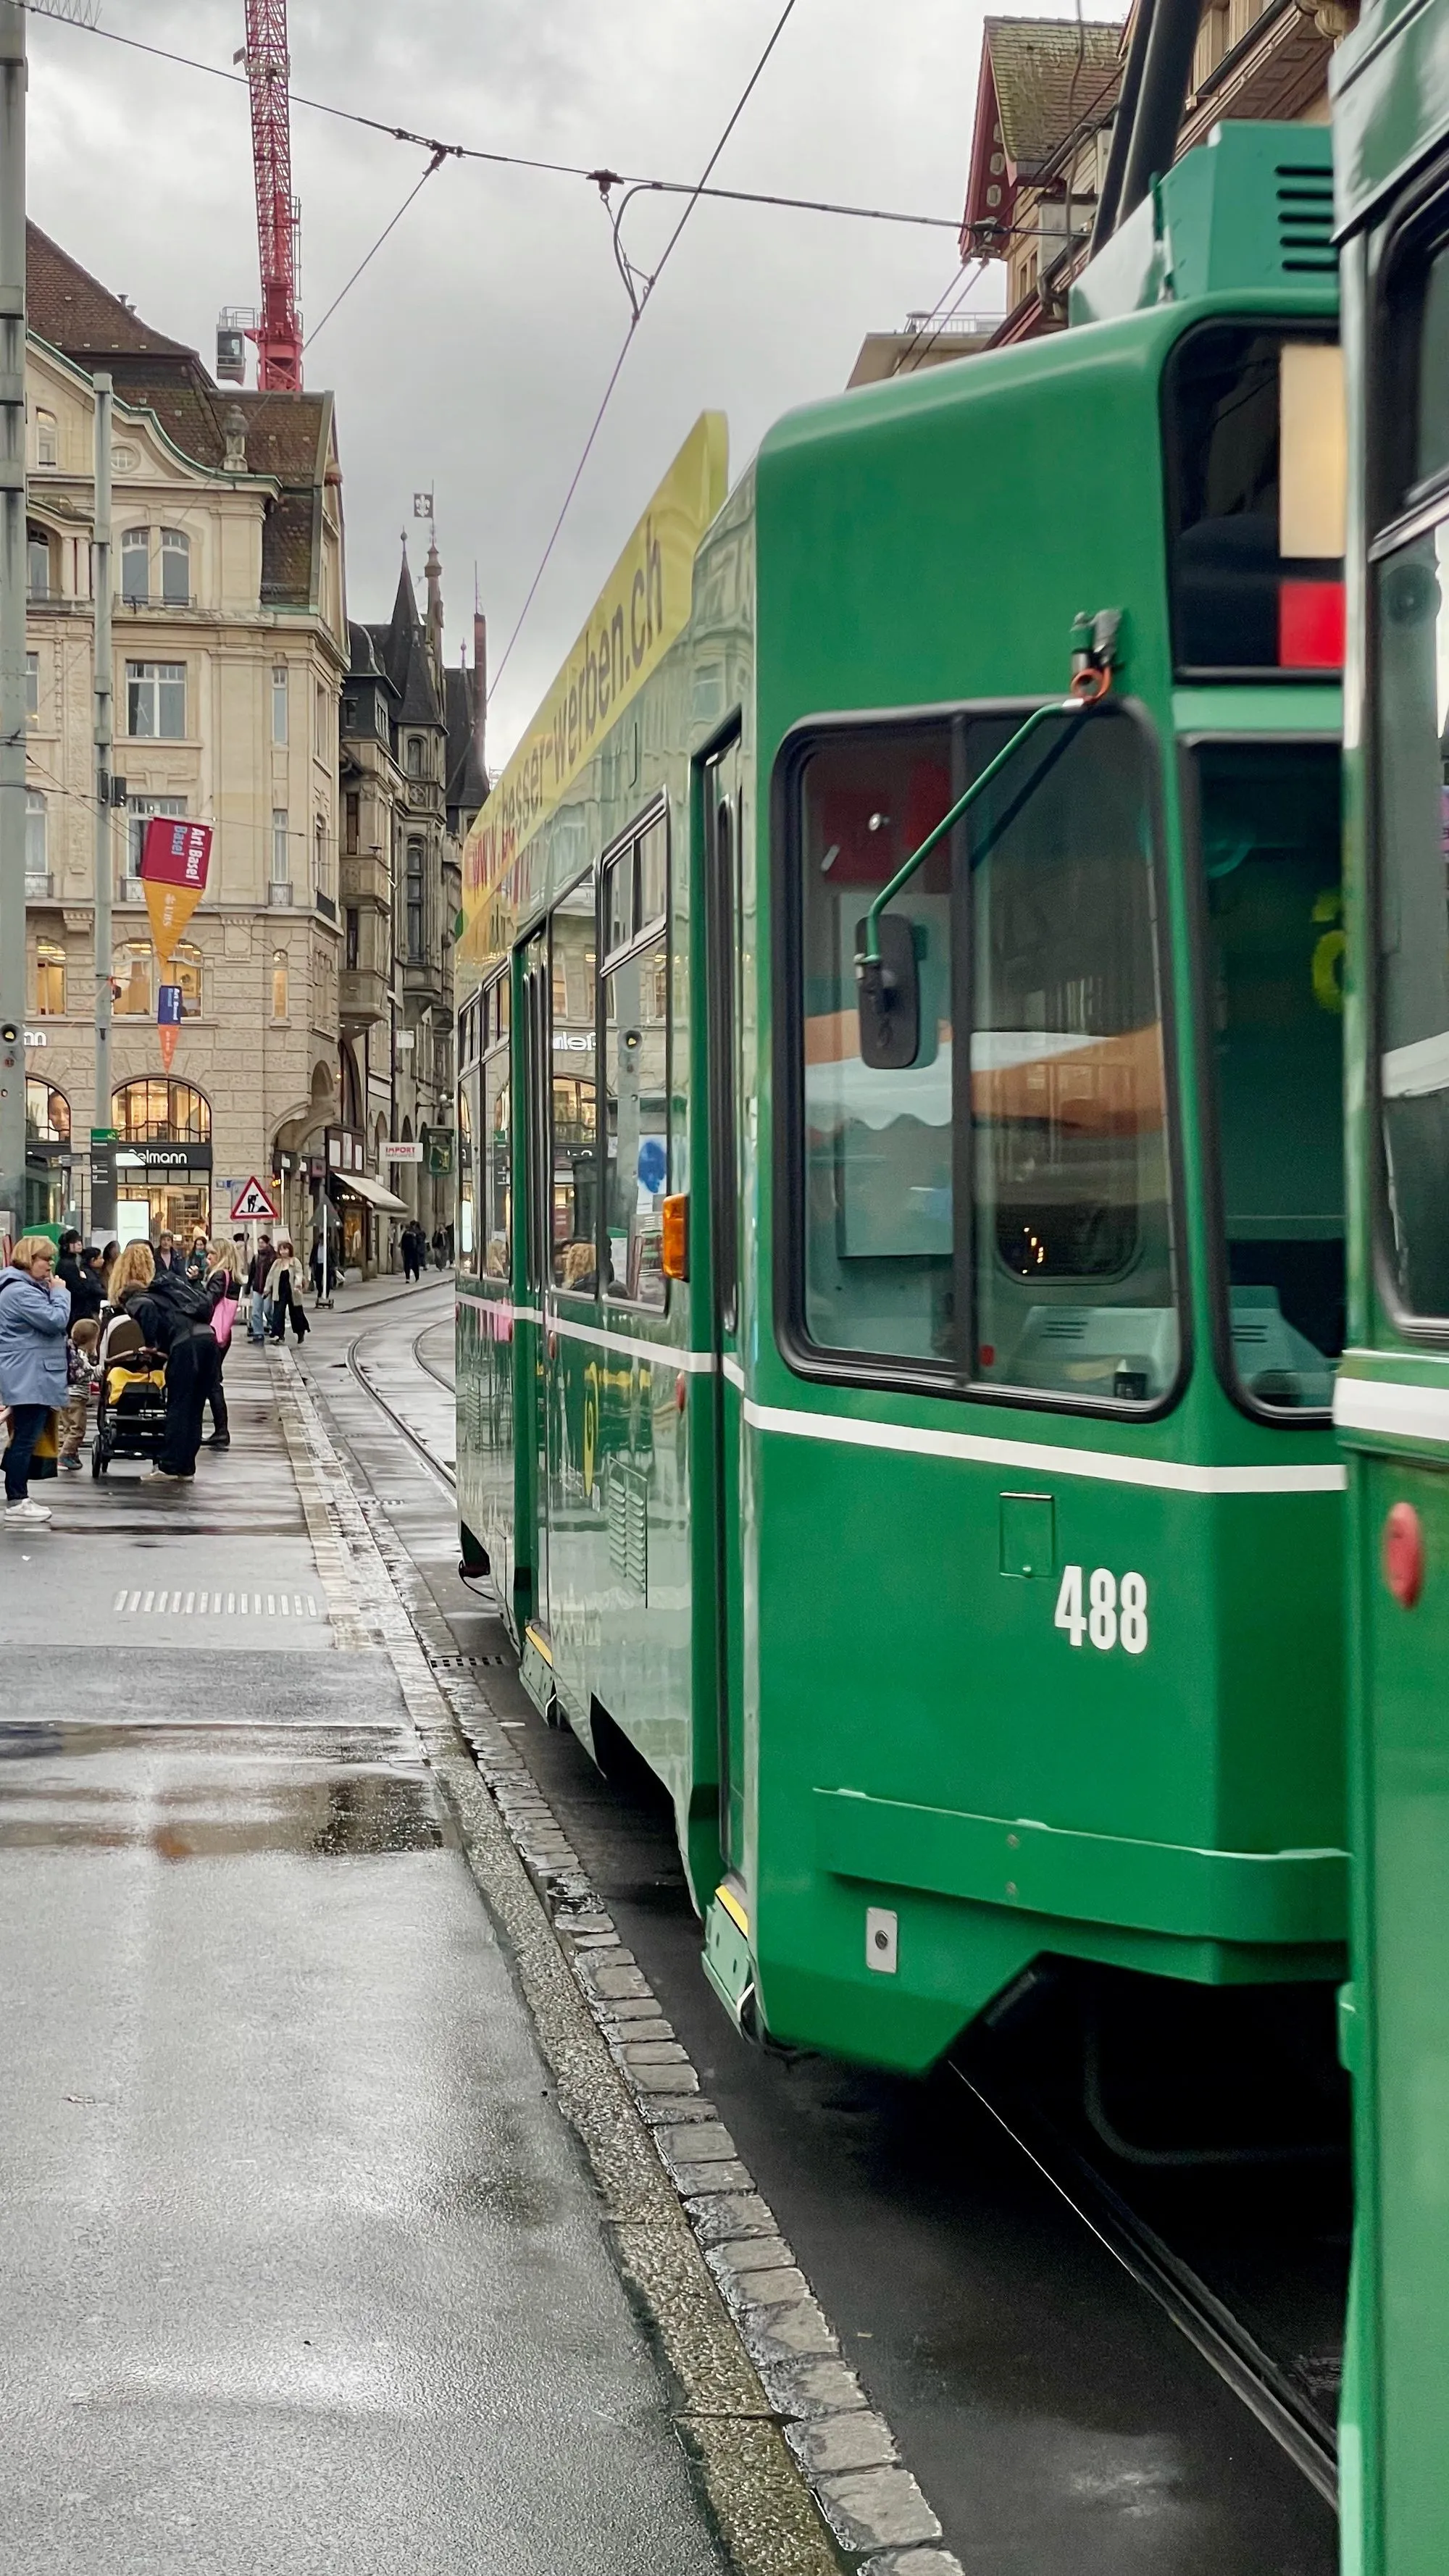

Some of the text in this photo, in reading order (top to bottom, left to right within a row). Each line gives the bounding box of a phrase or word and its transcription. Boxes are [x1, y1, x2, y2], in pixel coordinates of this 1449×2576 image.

[171, 824, 188, 856] Basel
[185, 827, 205, 880] Art Basel
[1054, 1565, 1148, 1654] 488
